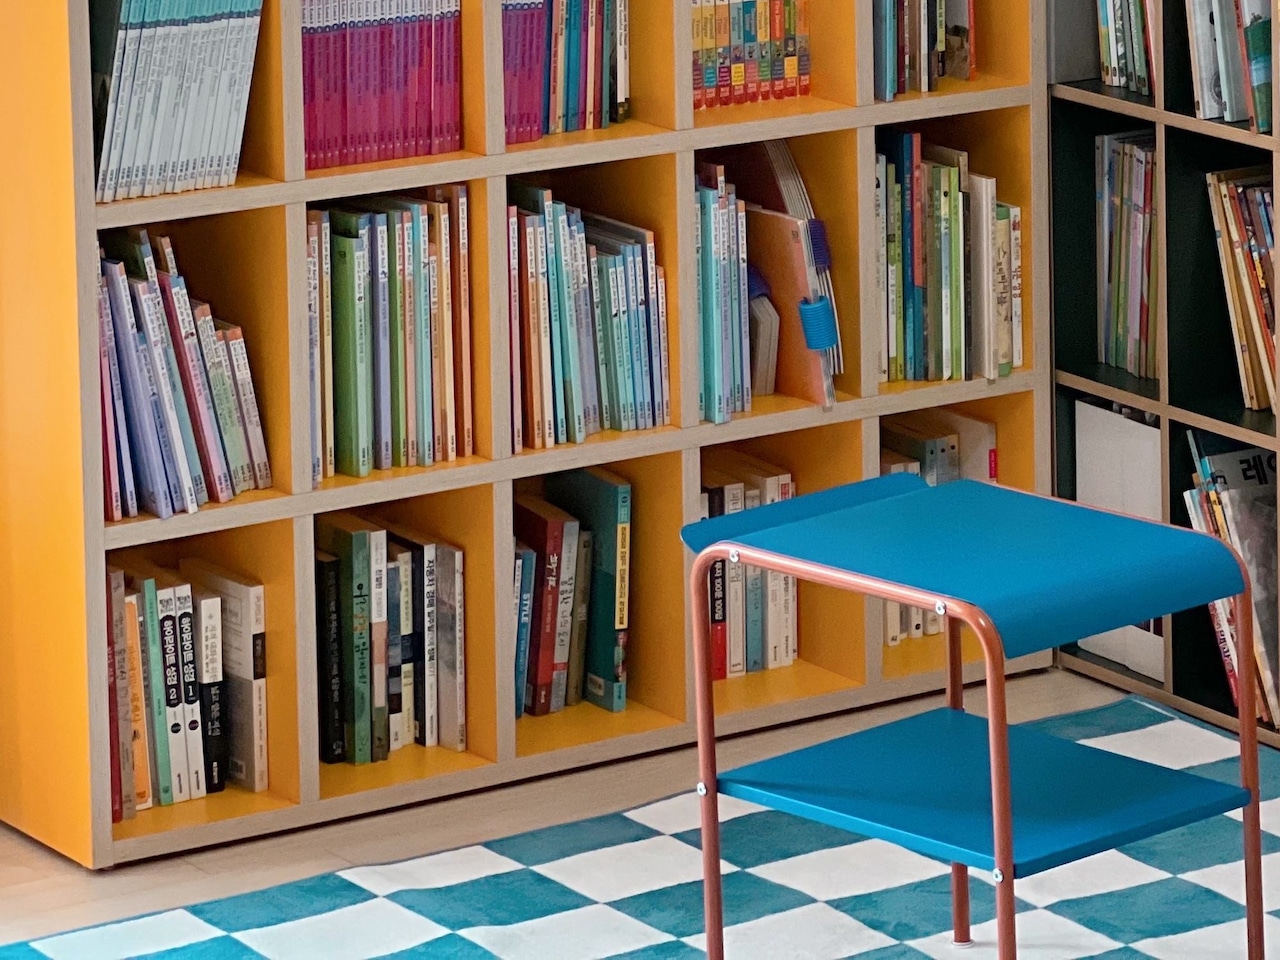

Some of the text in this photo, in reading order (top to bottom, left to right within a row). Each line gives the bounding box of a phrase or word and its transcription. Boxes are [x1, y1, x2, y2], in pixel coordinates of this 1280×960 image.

[426, 559, 435, 587] 자동차
[426, 590, 435, 608] 경매
[522, 593, 531, 623] STYLE
[163, 620, 179, 699] 하이라이트 성경 2
[181, 617, 196, 696] 하이라이트 성경 1
